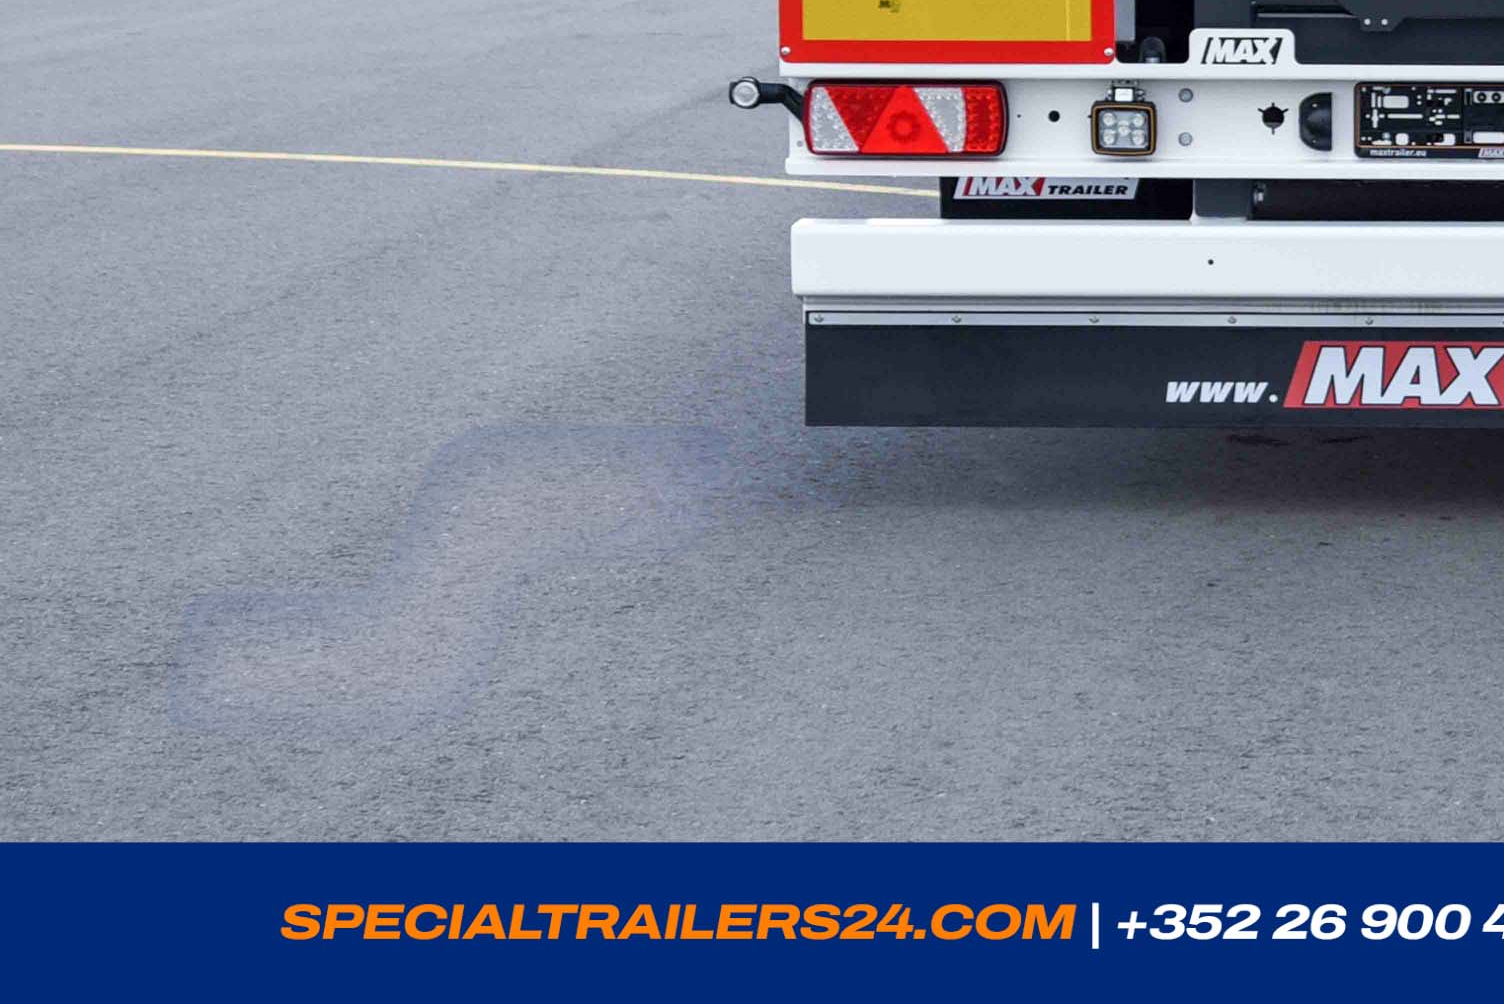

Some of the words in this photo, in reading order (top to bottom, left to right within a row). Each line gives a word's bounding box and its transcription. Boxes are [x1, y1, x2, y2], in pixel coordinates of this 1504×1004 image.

[1203, 37, 1282, 64] MAX
[967, 177, 1043, 196] MAX
[1048, 185, 1128, 195] TRAILER
